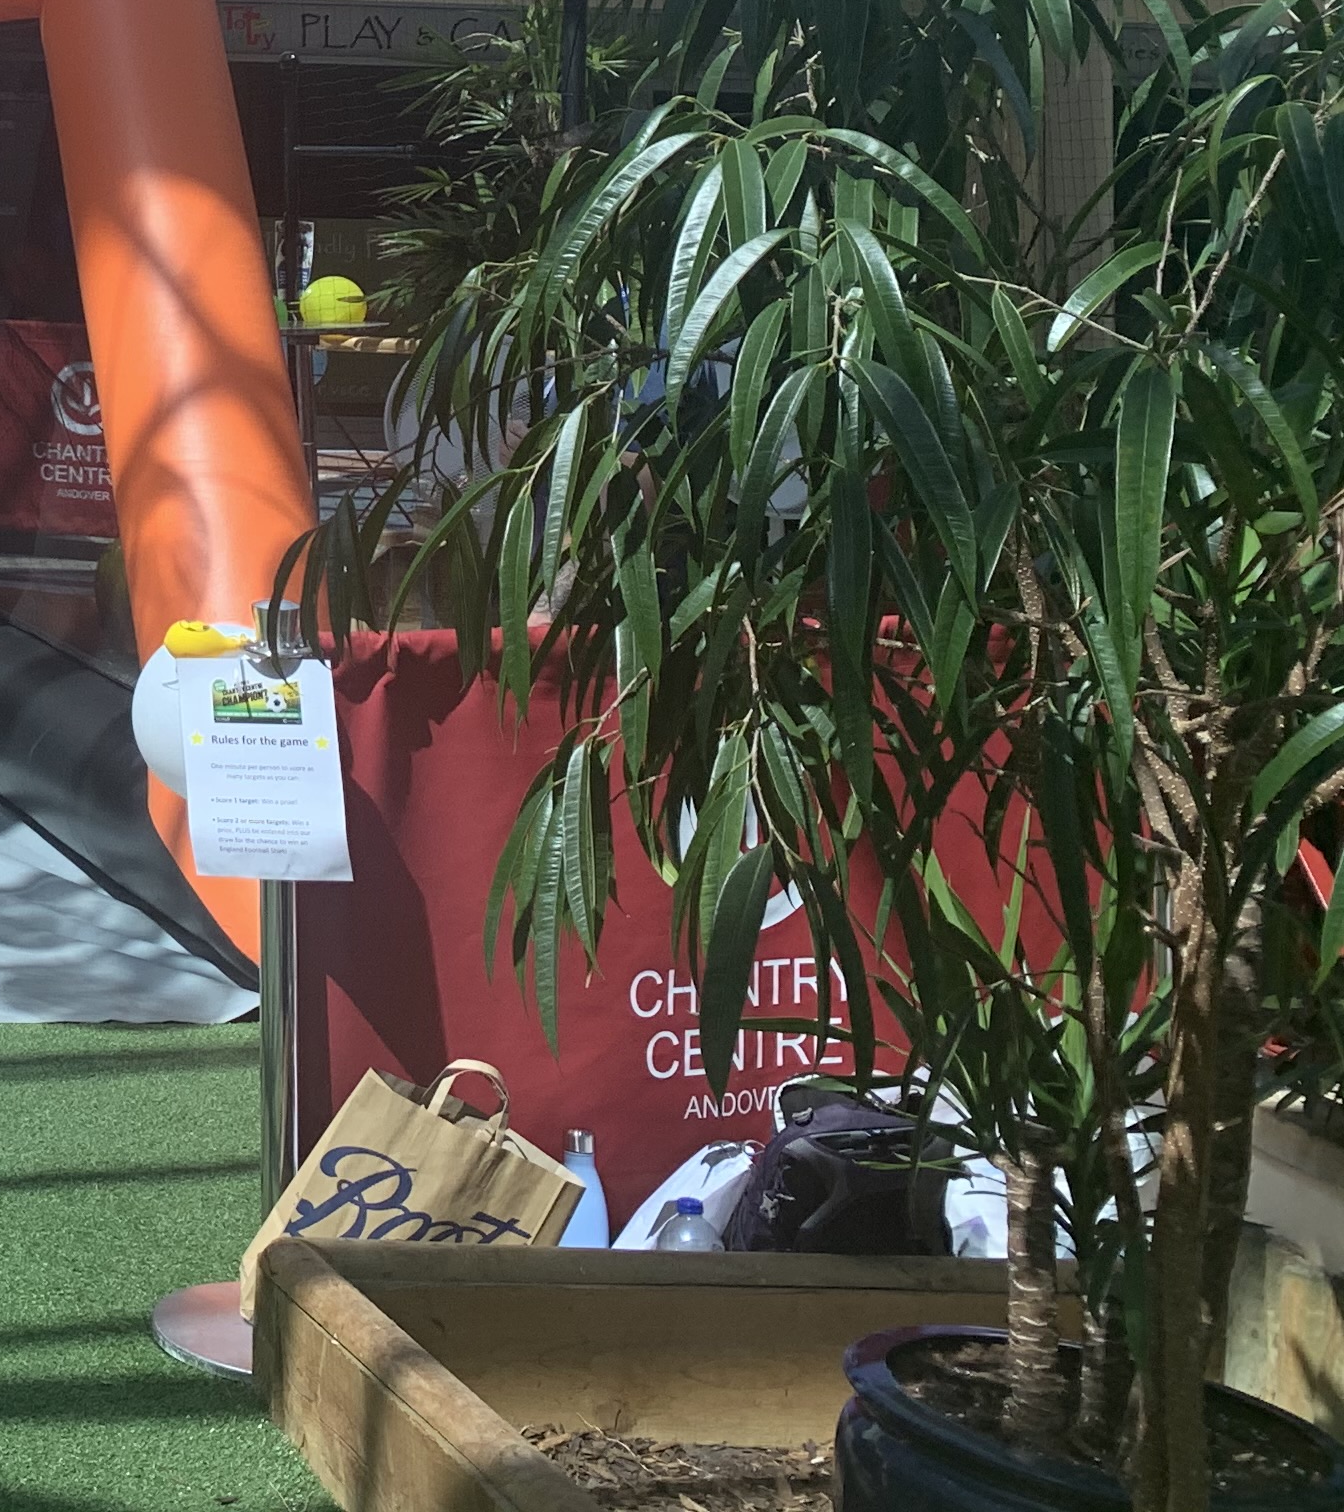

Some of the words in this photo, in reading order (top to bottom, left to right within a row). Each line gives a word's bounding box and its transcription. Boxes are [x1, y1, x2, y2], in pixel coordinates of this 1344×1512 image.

[301, 12, 402, 50] PLAY
[32, 442, 109, 464] CHANT
[40, 464, 113, 486] CENTR
[56, 489, 111, 501] ANDOVER
[211, 735, 239, 745] Rules
[242, 735, 256, 745] for
[260, 736, 276, 746] the
[280, 738, 309, 748] game
[629, 956, 848, 1018] CHNTRY
